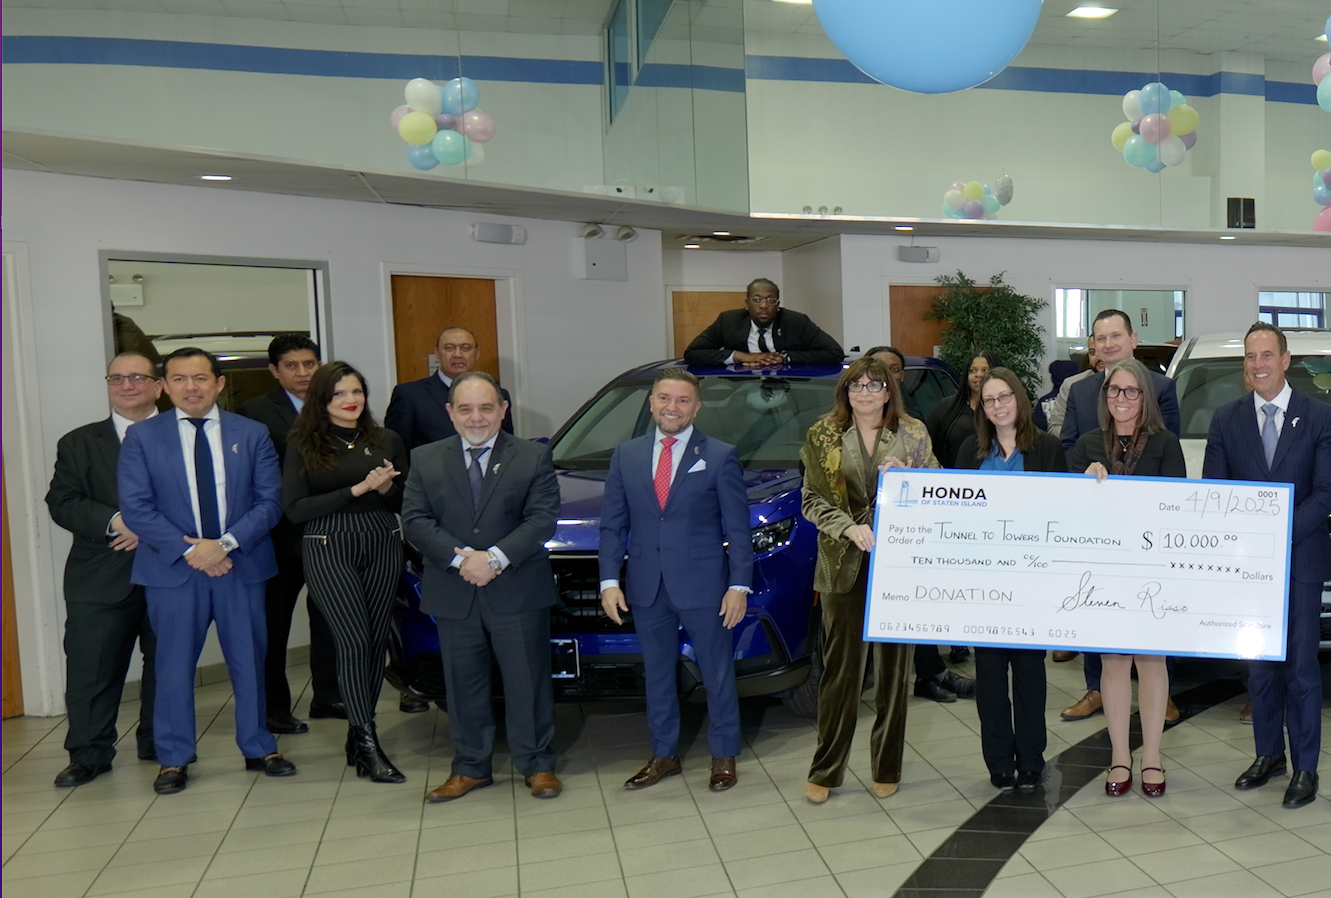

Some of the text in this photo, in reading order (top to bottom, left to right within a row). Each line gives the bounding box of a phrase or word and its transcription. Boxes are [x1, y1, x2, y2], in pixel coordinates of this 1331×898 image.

[922, 486, 987, 500] HONDA
[1159, 502, 1180, 512] Date
[1186, 488, 1280, 518] 4/9/2025
[889, 525, 905, 535] Pay
[918, 526, 932, 534] the
[934, 520, 1121, 546] TUNNEL TO TOWERS FOUNDATION
[888, 536, 925, 545] Order of
[1142, 531, 1153, 550] $
[911, 556, 932, 565] TEN
[936, 557, 992, 566] THOUSAND
[1242, 572, 1274, 582] Dollars
[882, 592, 909, 601] Memo
[915, 586, 1012, 602] DONATION
[1056, 570, 1126, 612] Steven
